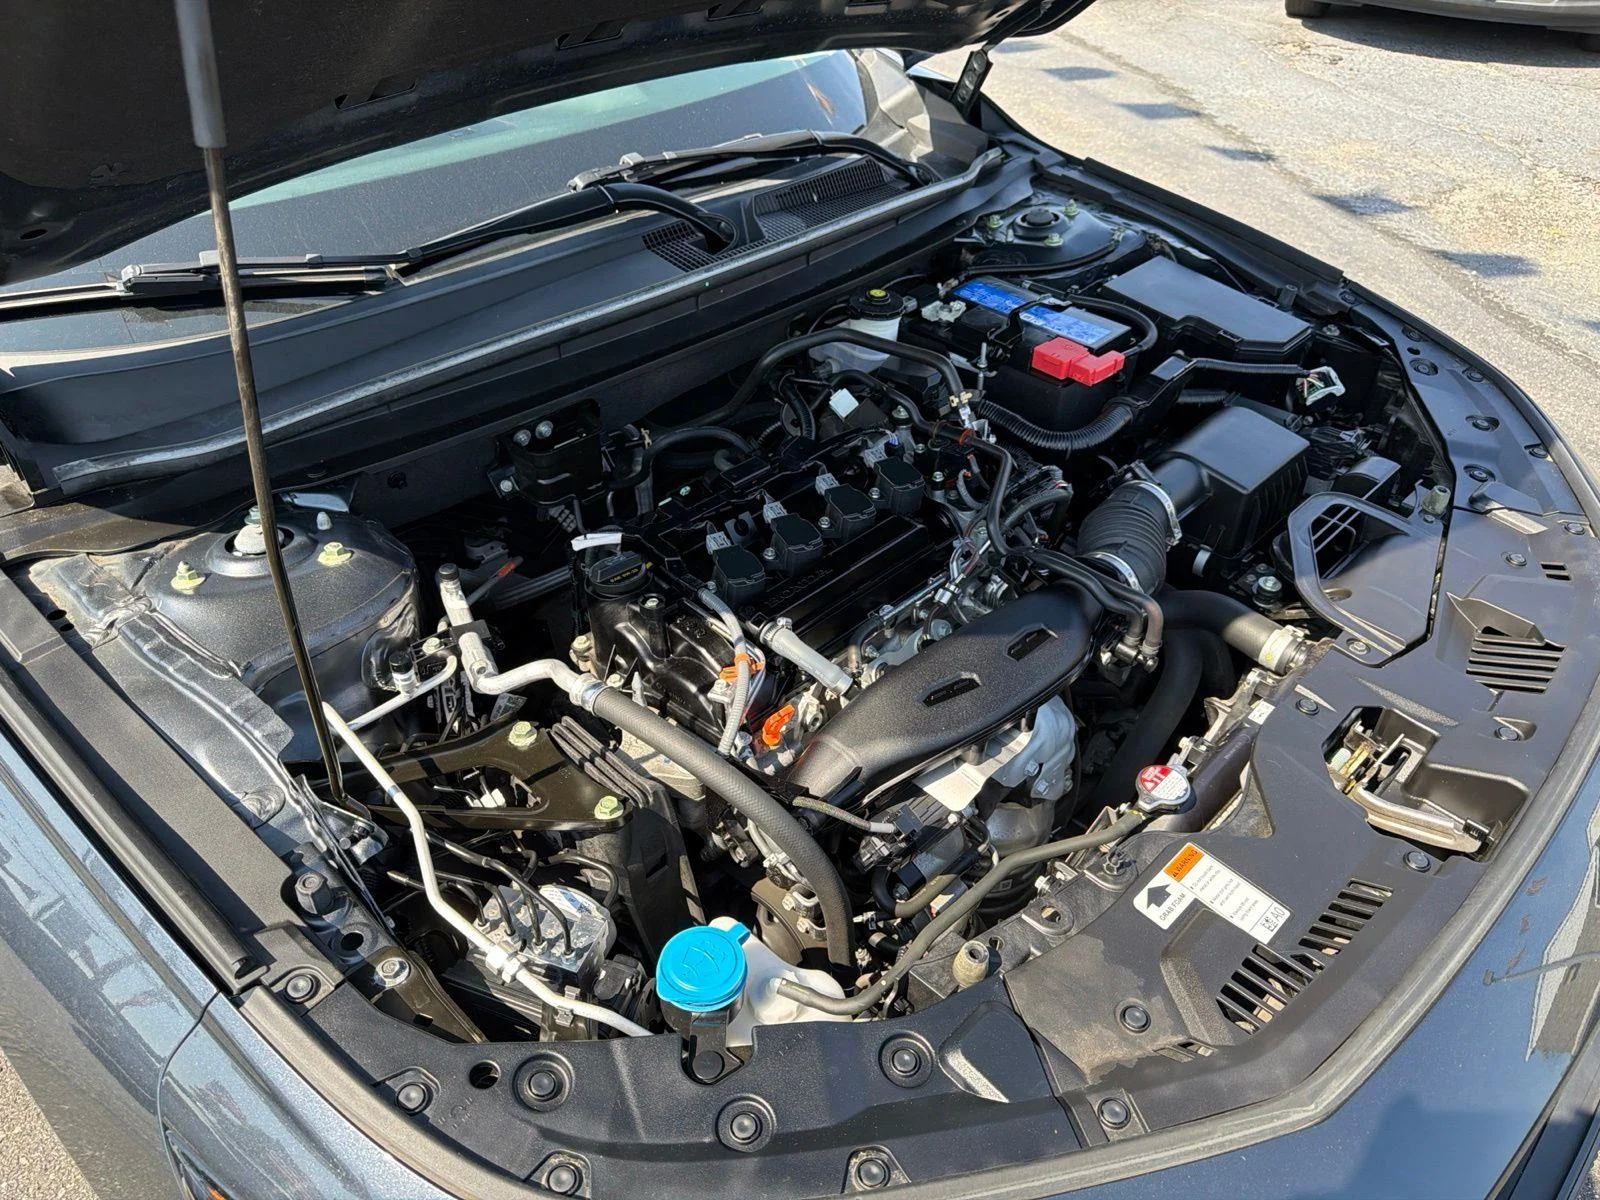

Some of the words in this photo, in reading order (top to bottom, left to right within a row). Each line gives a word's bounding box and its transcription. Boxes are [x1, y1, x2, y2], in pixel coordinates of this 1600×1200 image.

[1176, 849, 1198, 872] WARNING
[1160, 906, 1175, 921] GRAB
[1171, 893, 1186, 908] FOAM
